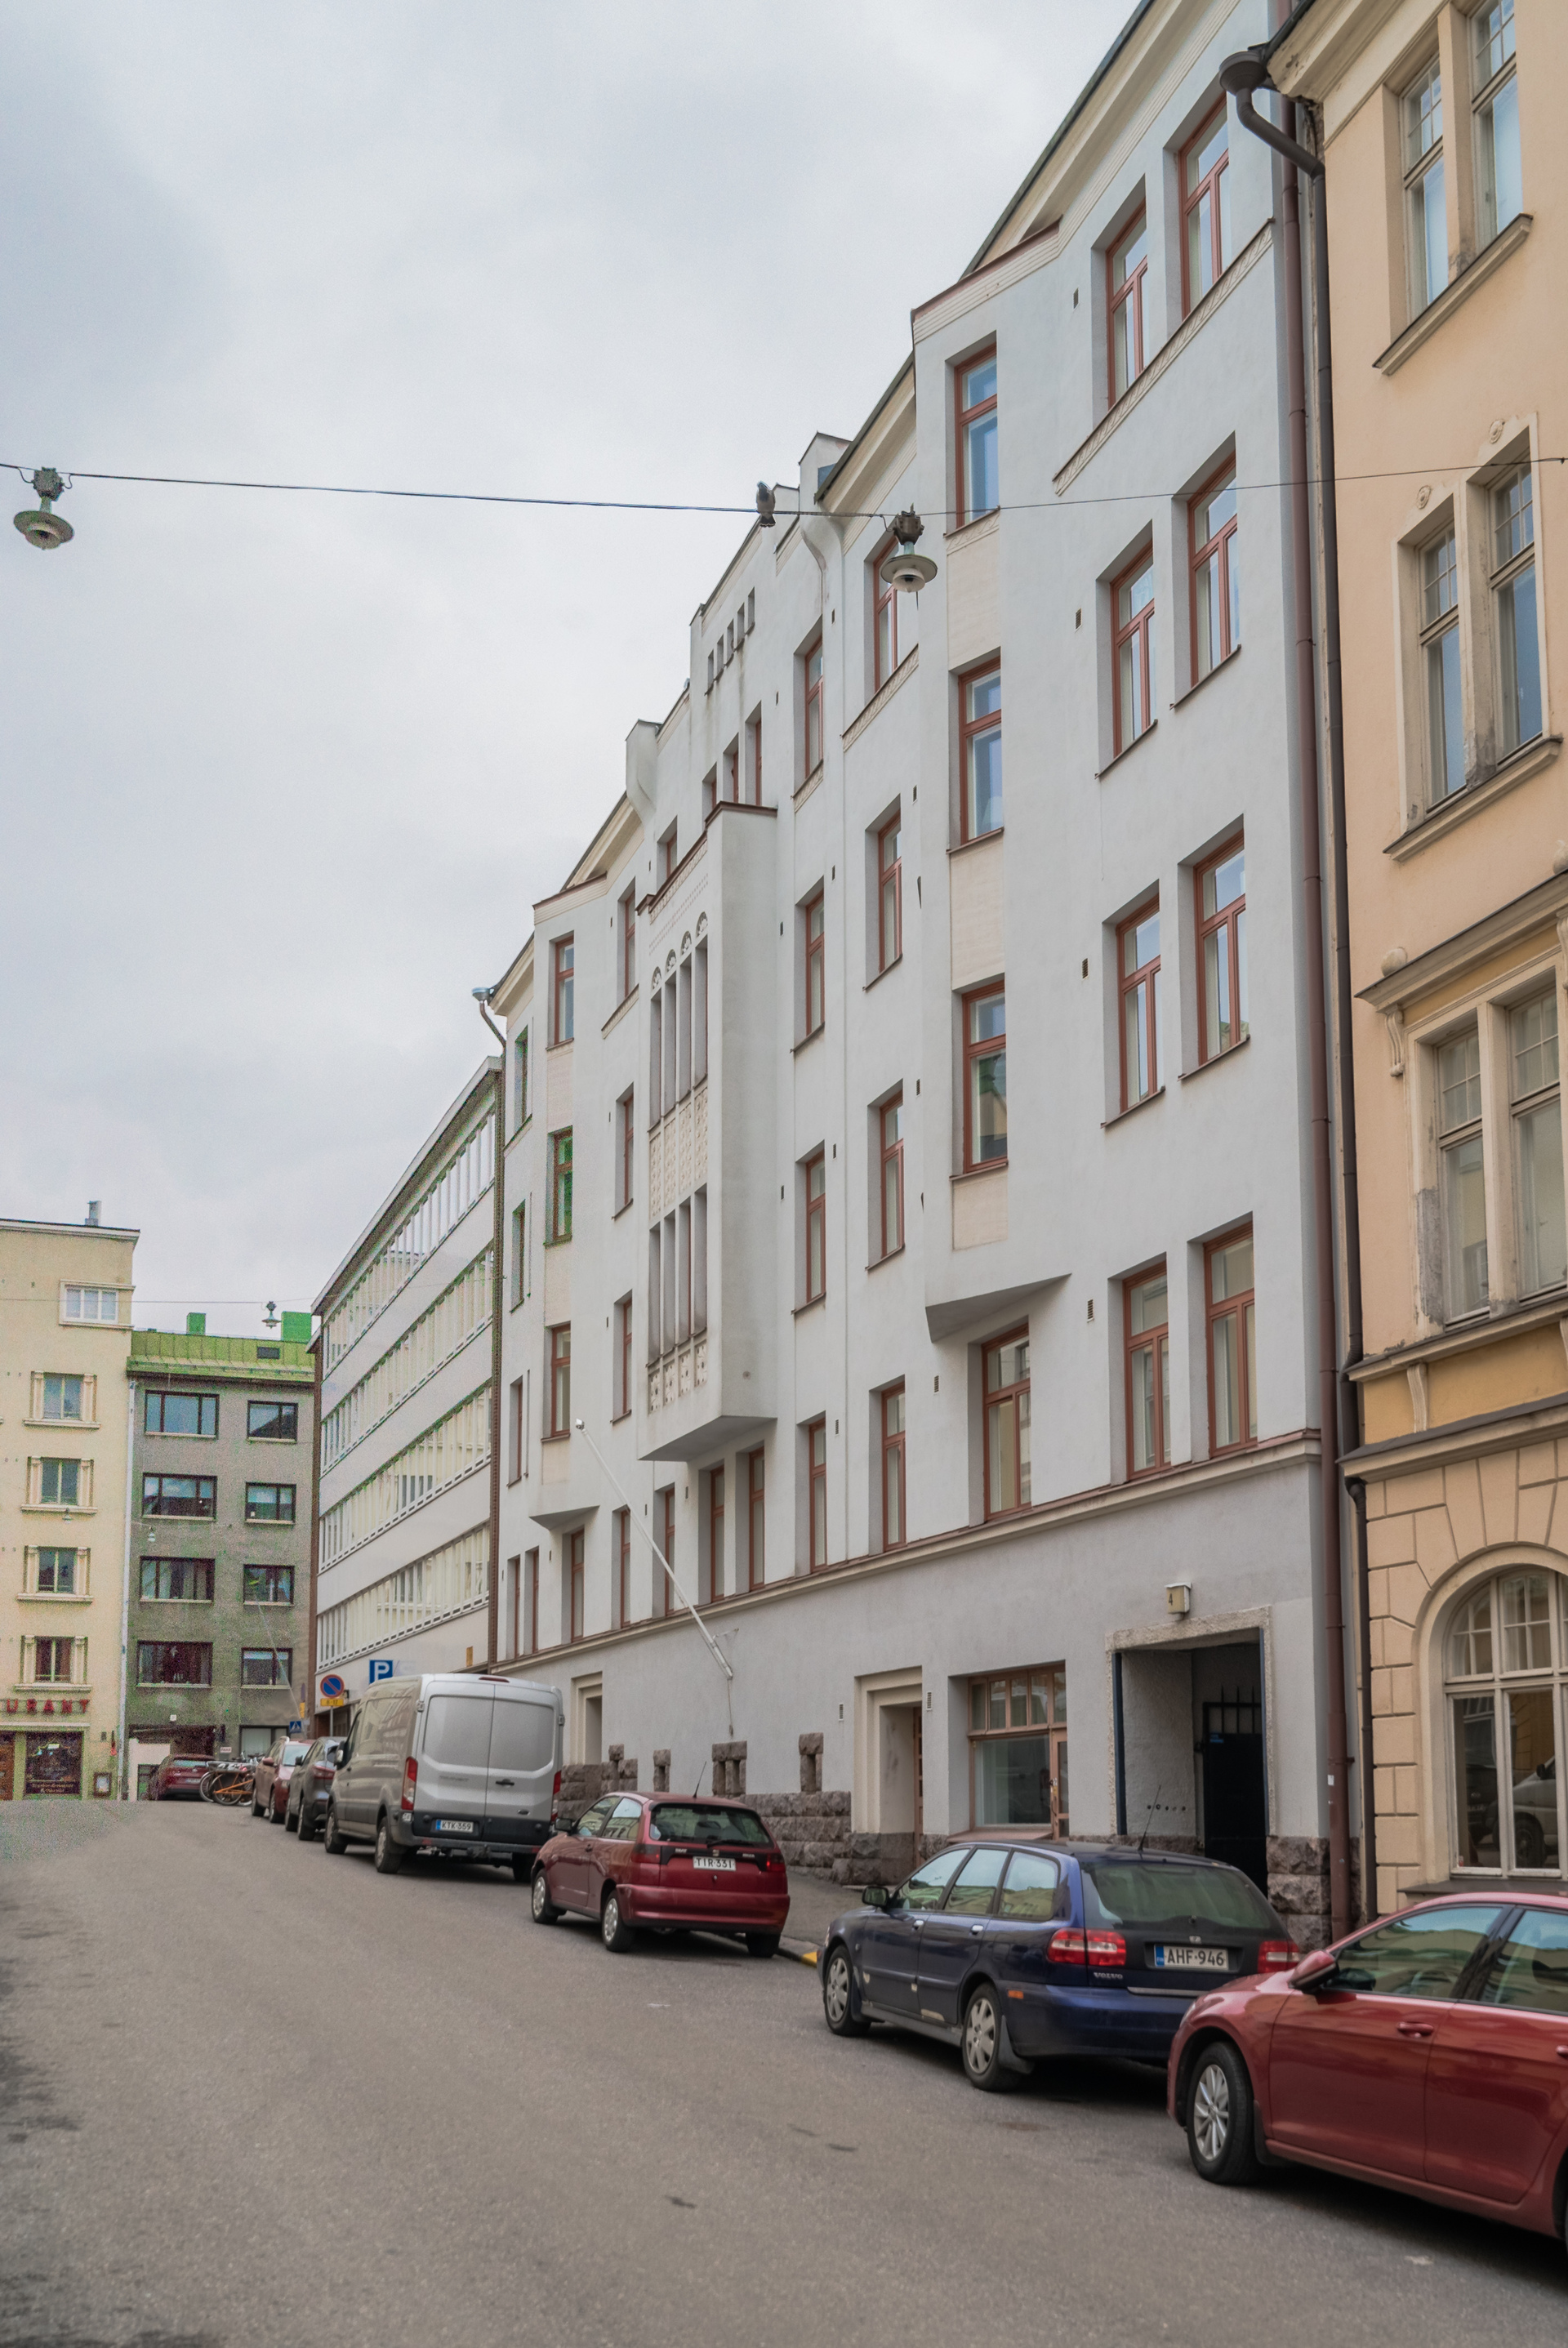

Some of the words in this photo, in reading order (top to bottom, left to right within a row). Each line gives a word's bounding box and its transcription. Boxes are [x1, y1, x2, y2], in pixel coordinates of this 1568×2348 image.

[1169, 1593, 1173, 1606] 4
[374, 1662, 390, 1680] P
[442, 1821, 471, 1830] KTK-359
[696, 1858, 732, 1869] TIR-331
[1167, 1949, 1224, 1966] AHF-946
